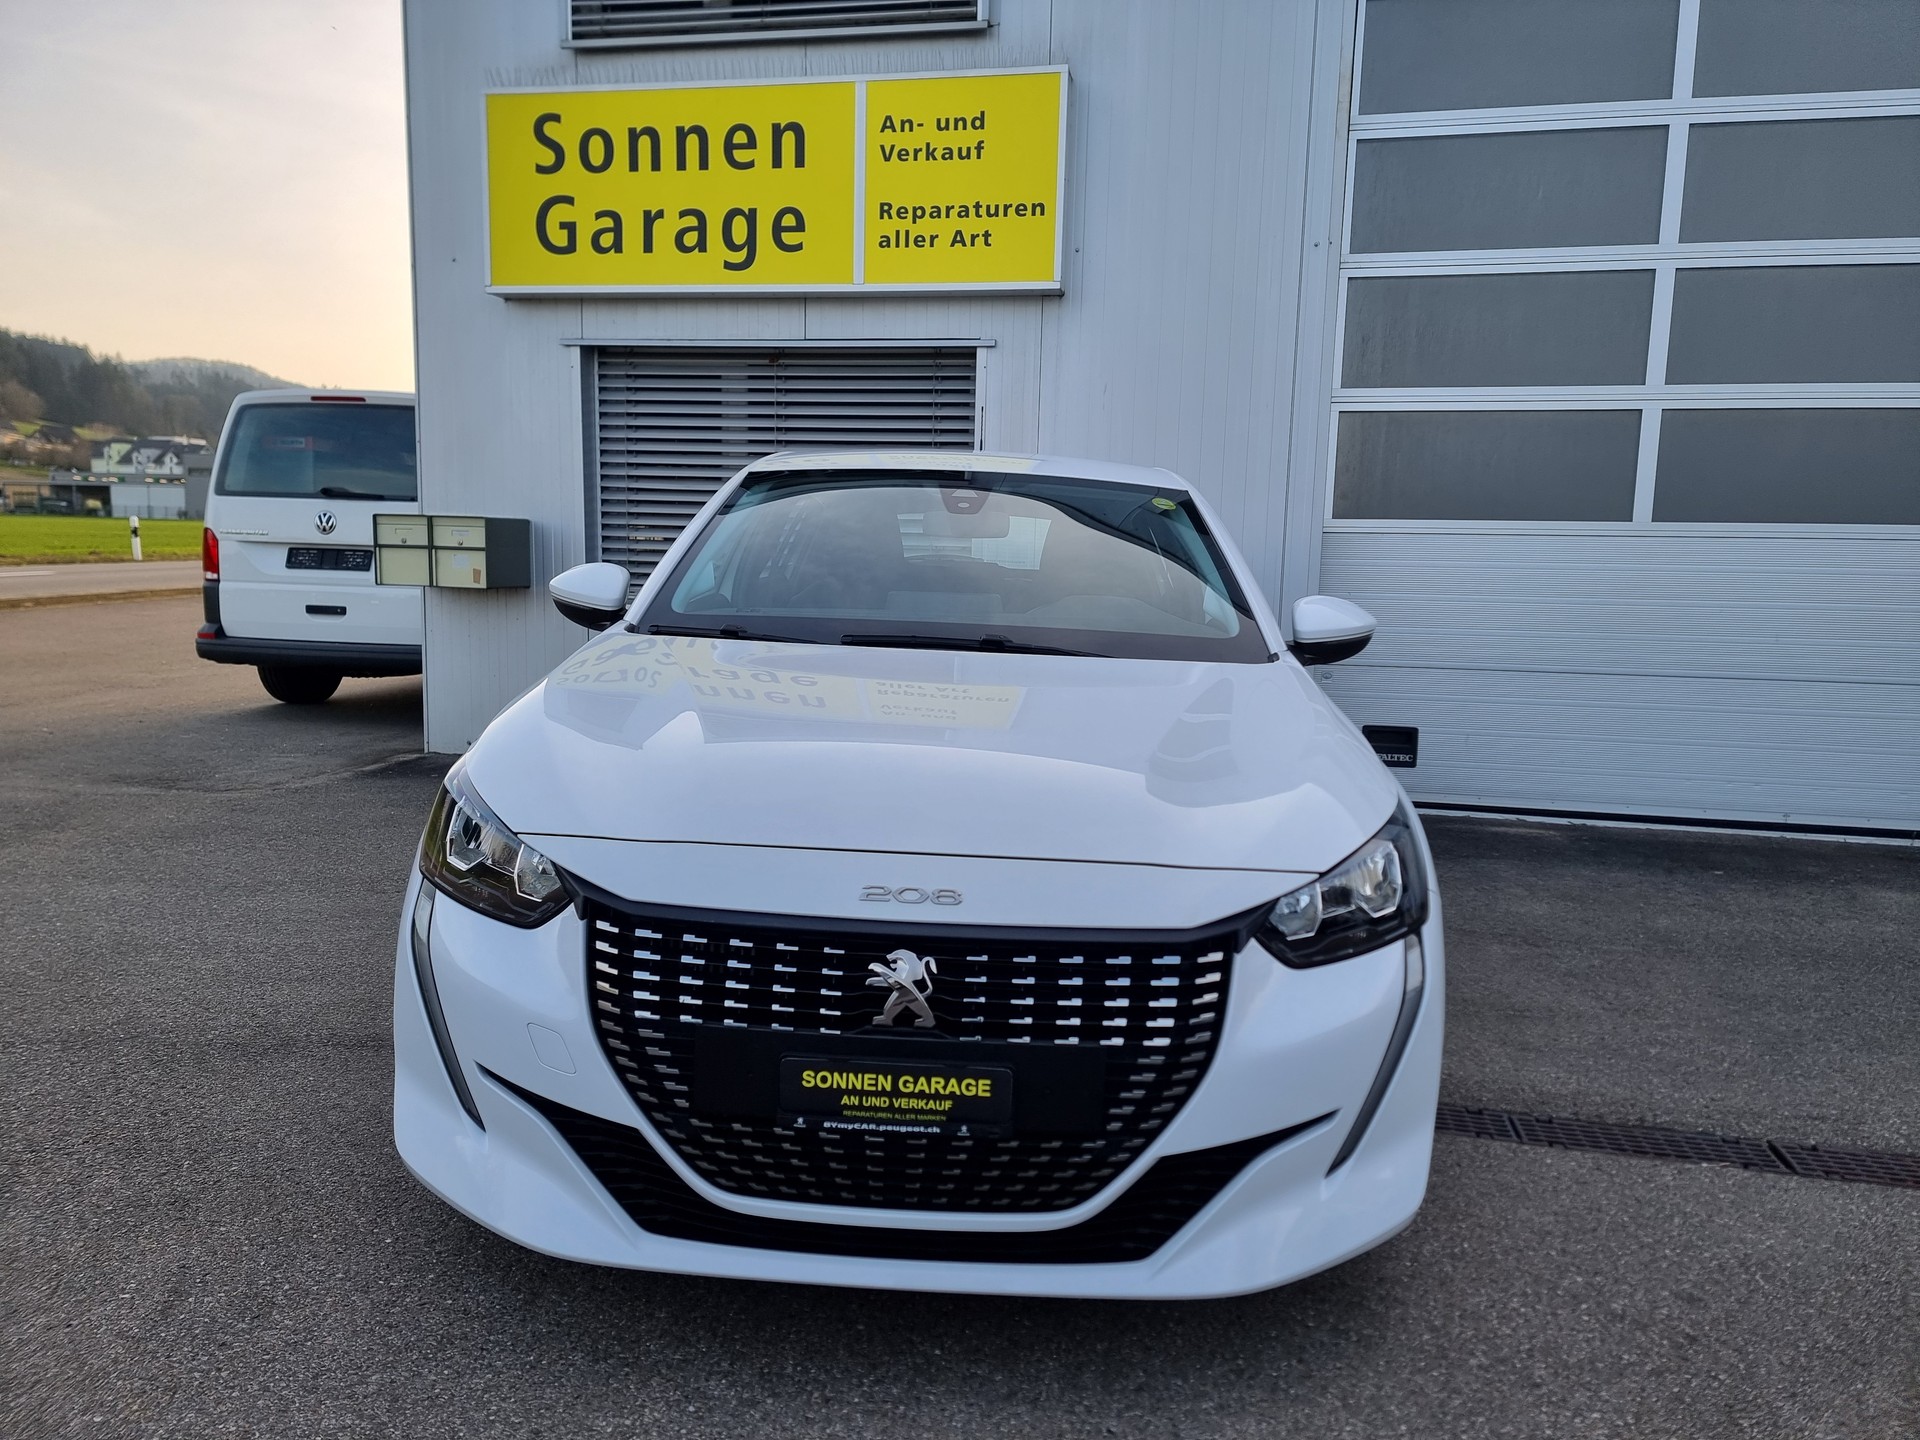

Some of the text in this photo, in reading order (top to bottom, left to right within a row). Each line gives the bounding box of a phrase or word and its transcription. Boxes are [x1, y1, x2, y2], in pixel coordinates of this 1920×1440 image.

[880, 110, 986, 133] An- und
[533, 112, 806, 175] Sonnen
[879, 140, 985, 162] Verkauf
[879, 200, 1046, 225] Reparaturen
[535, 194, 806, 271] Garage
[878, 229, 993, 249] aller Art
[859, 885, 964, 906] 208
[801, 1070, 992, 1097] SONNEN GARAGE
[840, 1095, 953, 1111] AN UND VERKAUF
[842, 1110, 893, 1118] REPARATUREN
[894, 1112, 916, 1120] ALLER
